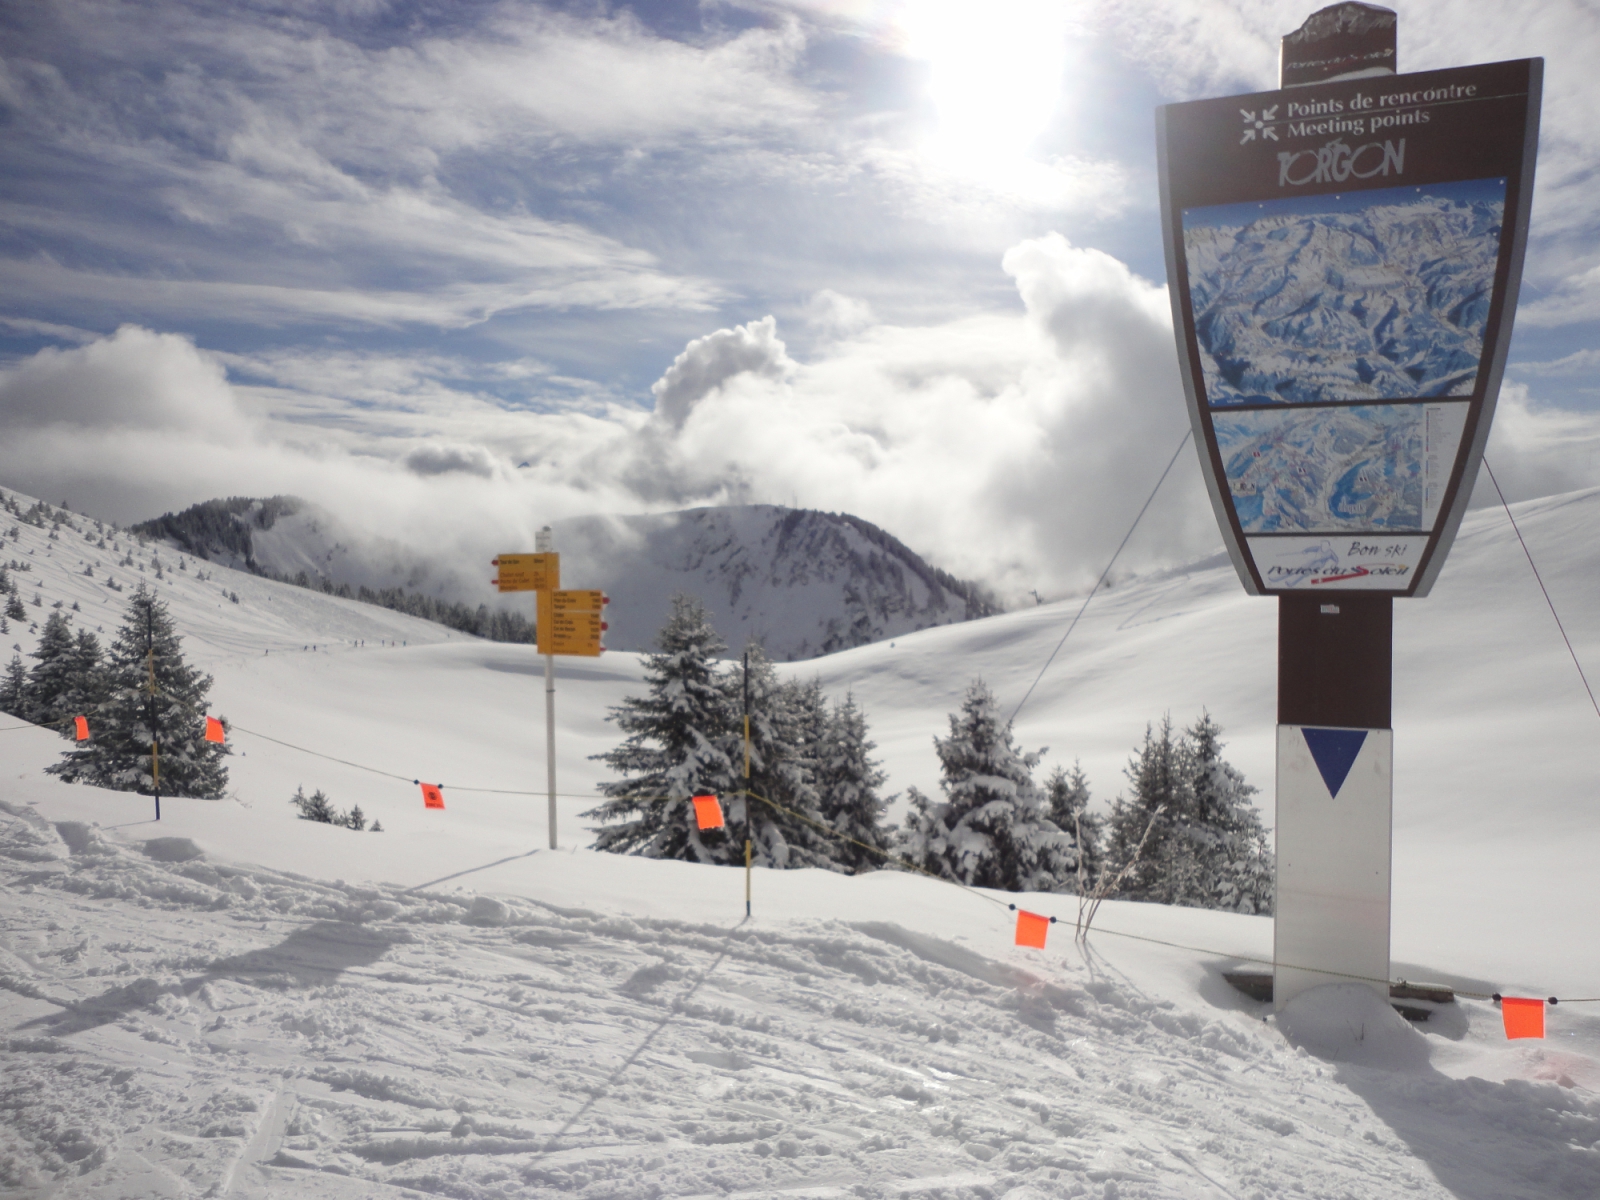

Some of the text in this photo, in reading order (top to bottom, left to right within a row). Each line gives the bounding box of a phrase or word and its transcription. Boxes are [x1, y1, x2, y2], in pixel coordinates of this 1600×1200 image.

[1287, 83, 1477, 118] Points de rencontre
[1287, 108, 1430, 138] Meeting points
[1277, 138, 1406, 187] TORGON
[1347, 541, 1408, 557] Bon ski
[1267, 563, 1409, 576] Portes du Soleil
